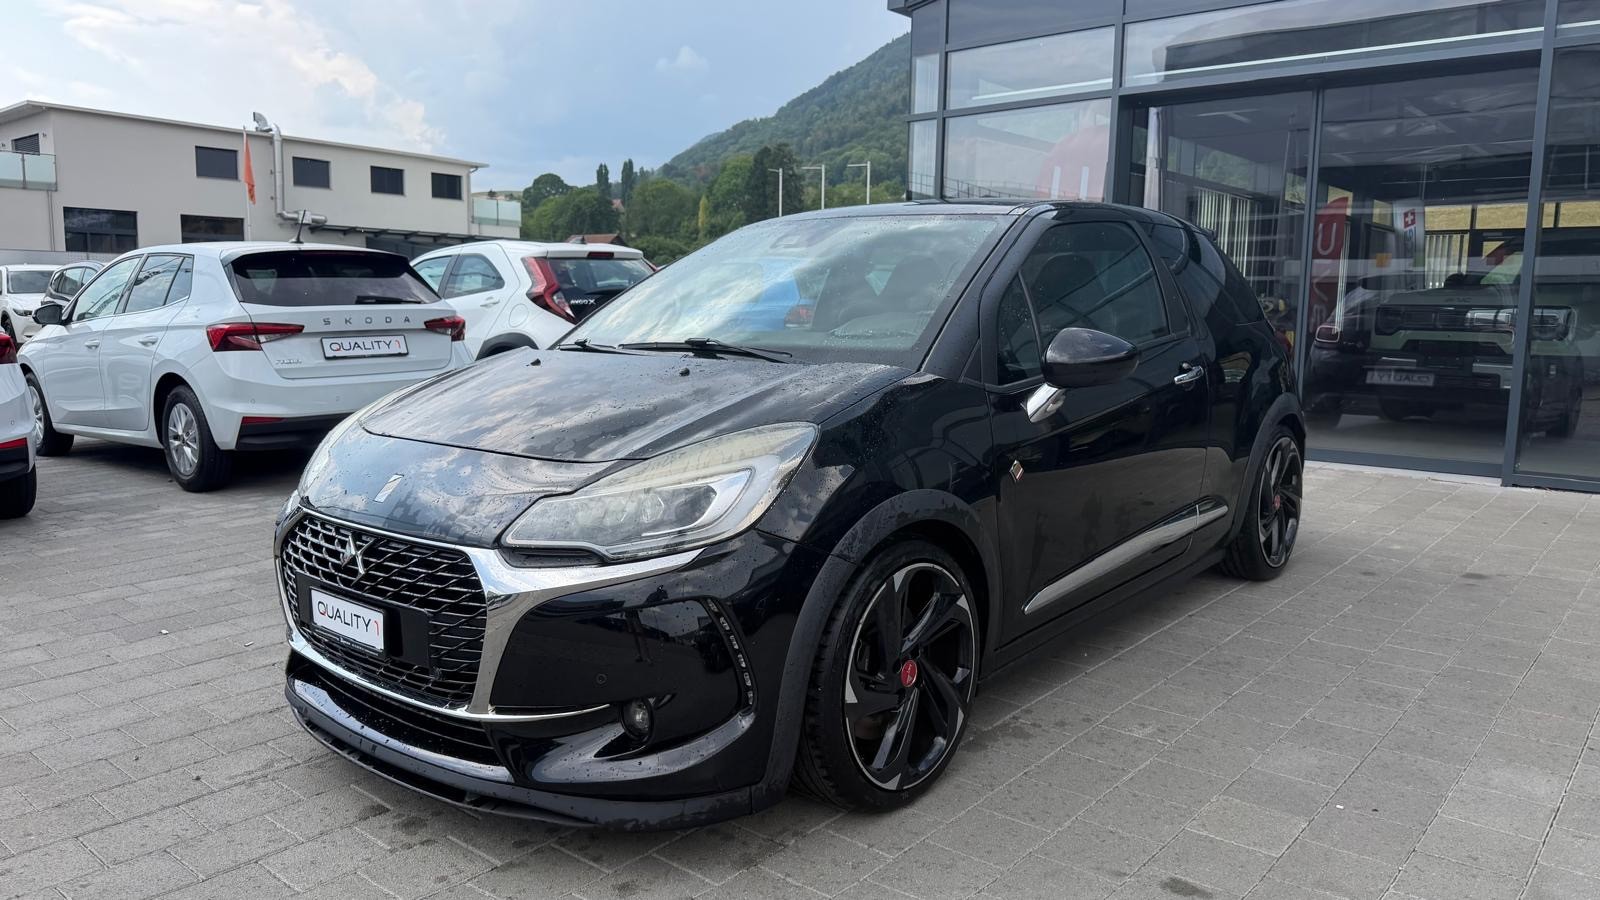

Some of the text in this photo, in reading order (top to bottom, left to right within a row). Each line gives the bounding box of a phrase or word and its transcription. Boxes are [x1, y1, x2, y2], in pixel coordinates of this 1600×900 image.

[329, 339, 401, 352] QUALITY 1
[317, 600, 379, 636] QUALITY 1
